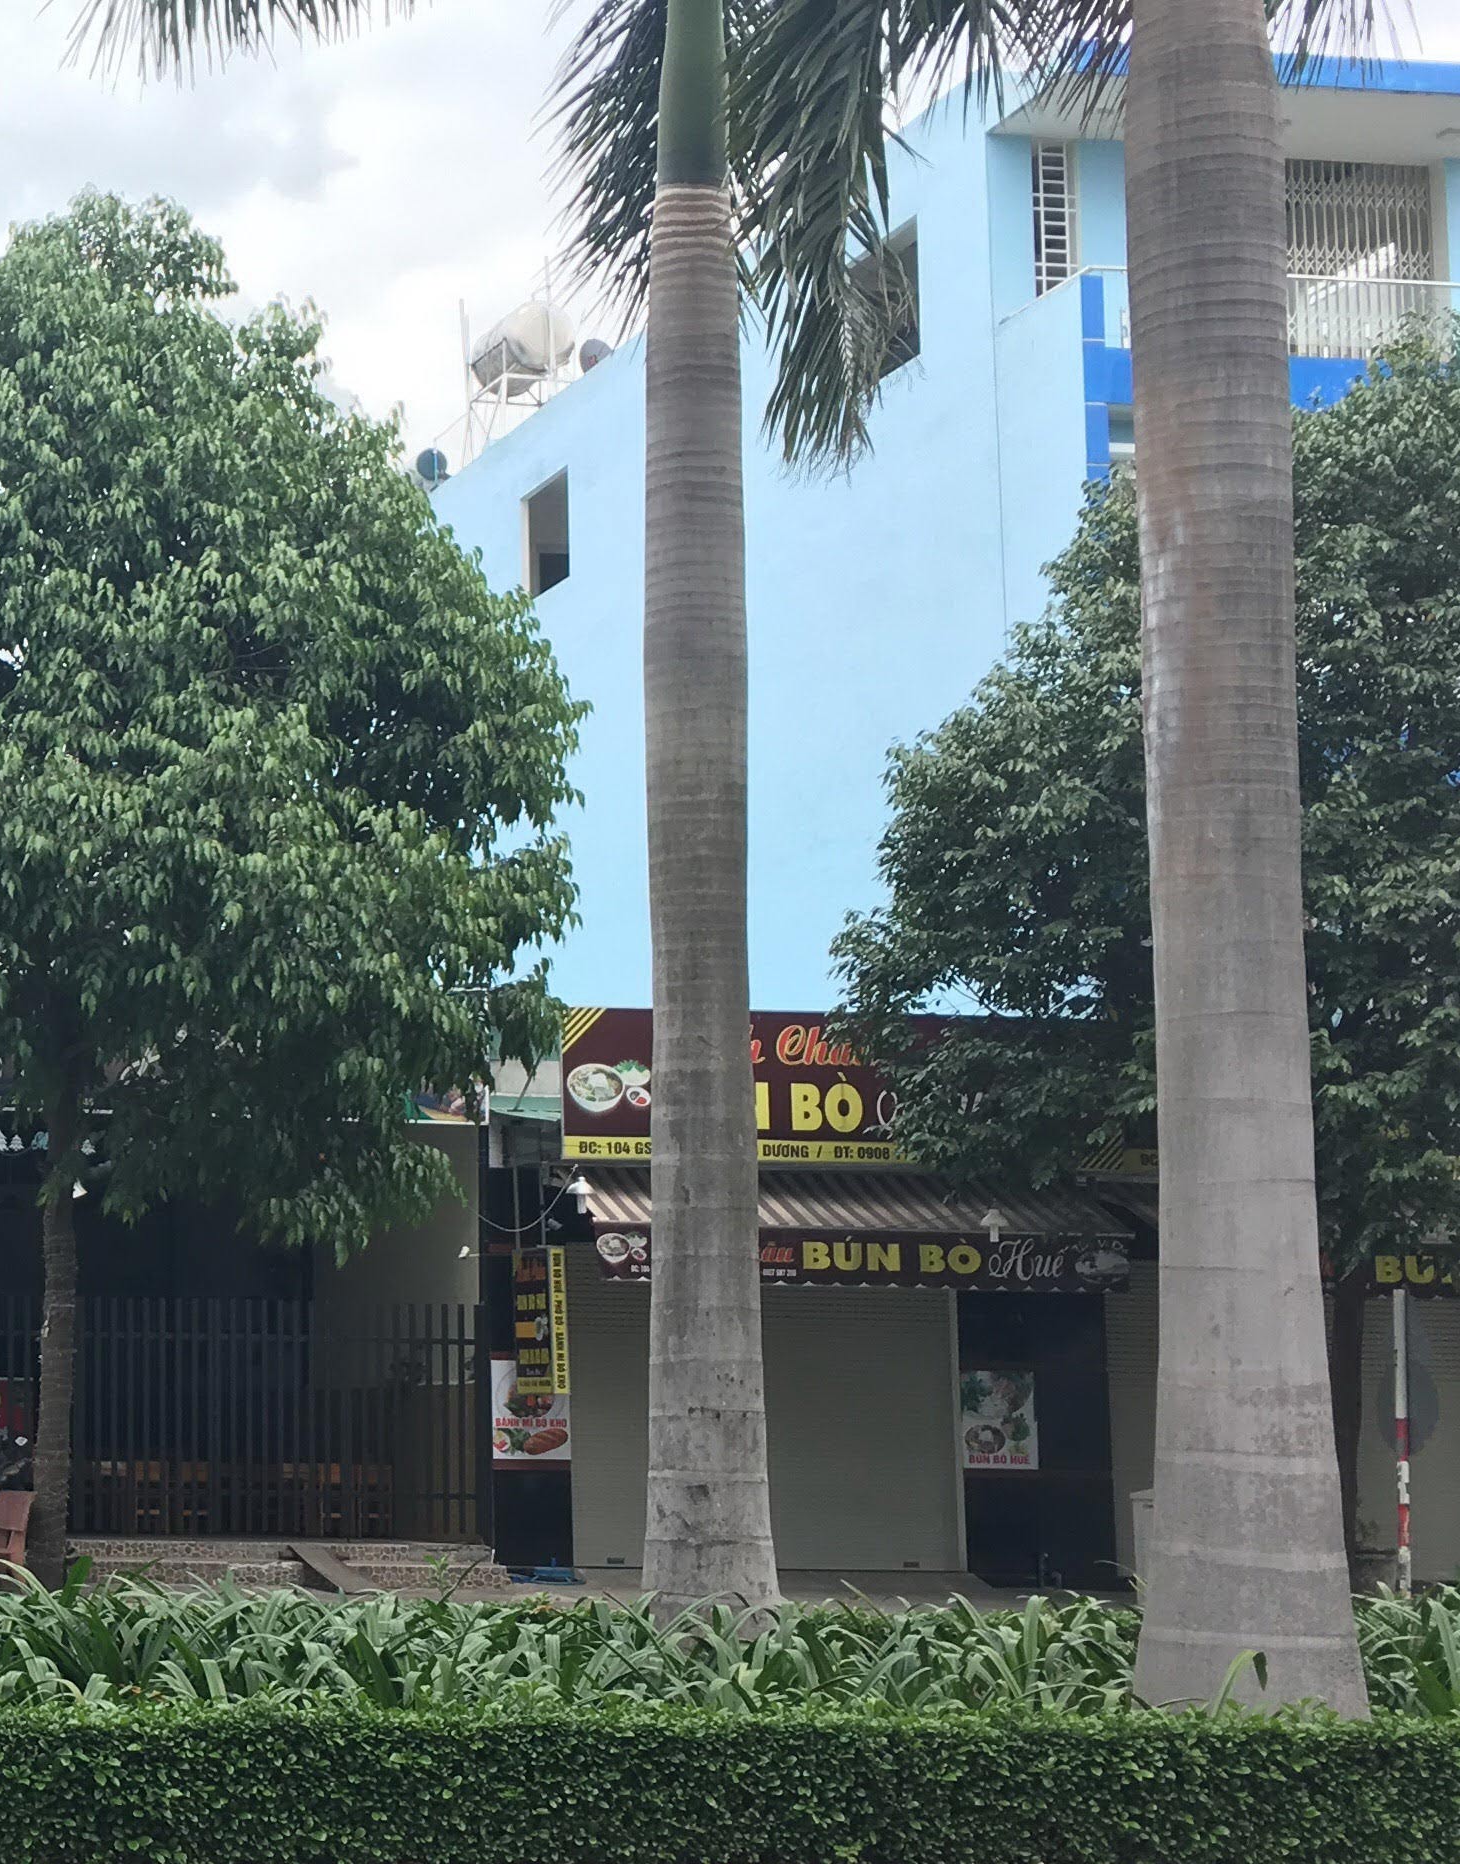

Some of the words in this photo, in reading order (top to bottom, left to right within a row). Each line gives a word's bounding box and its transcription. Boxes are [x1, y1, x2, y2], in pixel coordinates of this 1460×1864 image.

[790, 1071, 864, 1133] BÒ
[606, 1141, 630, 1155] 104
[762, 1143, 810, 1158] DƯƠNG
[802, 1236, 901, 1272] BÚN
[918, 1238, 982, 1274] BÒ
[988, 1238, 1069, 1281] Huế
